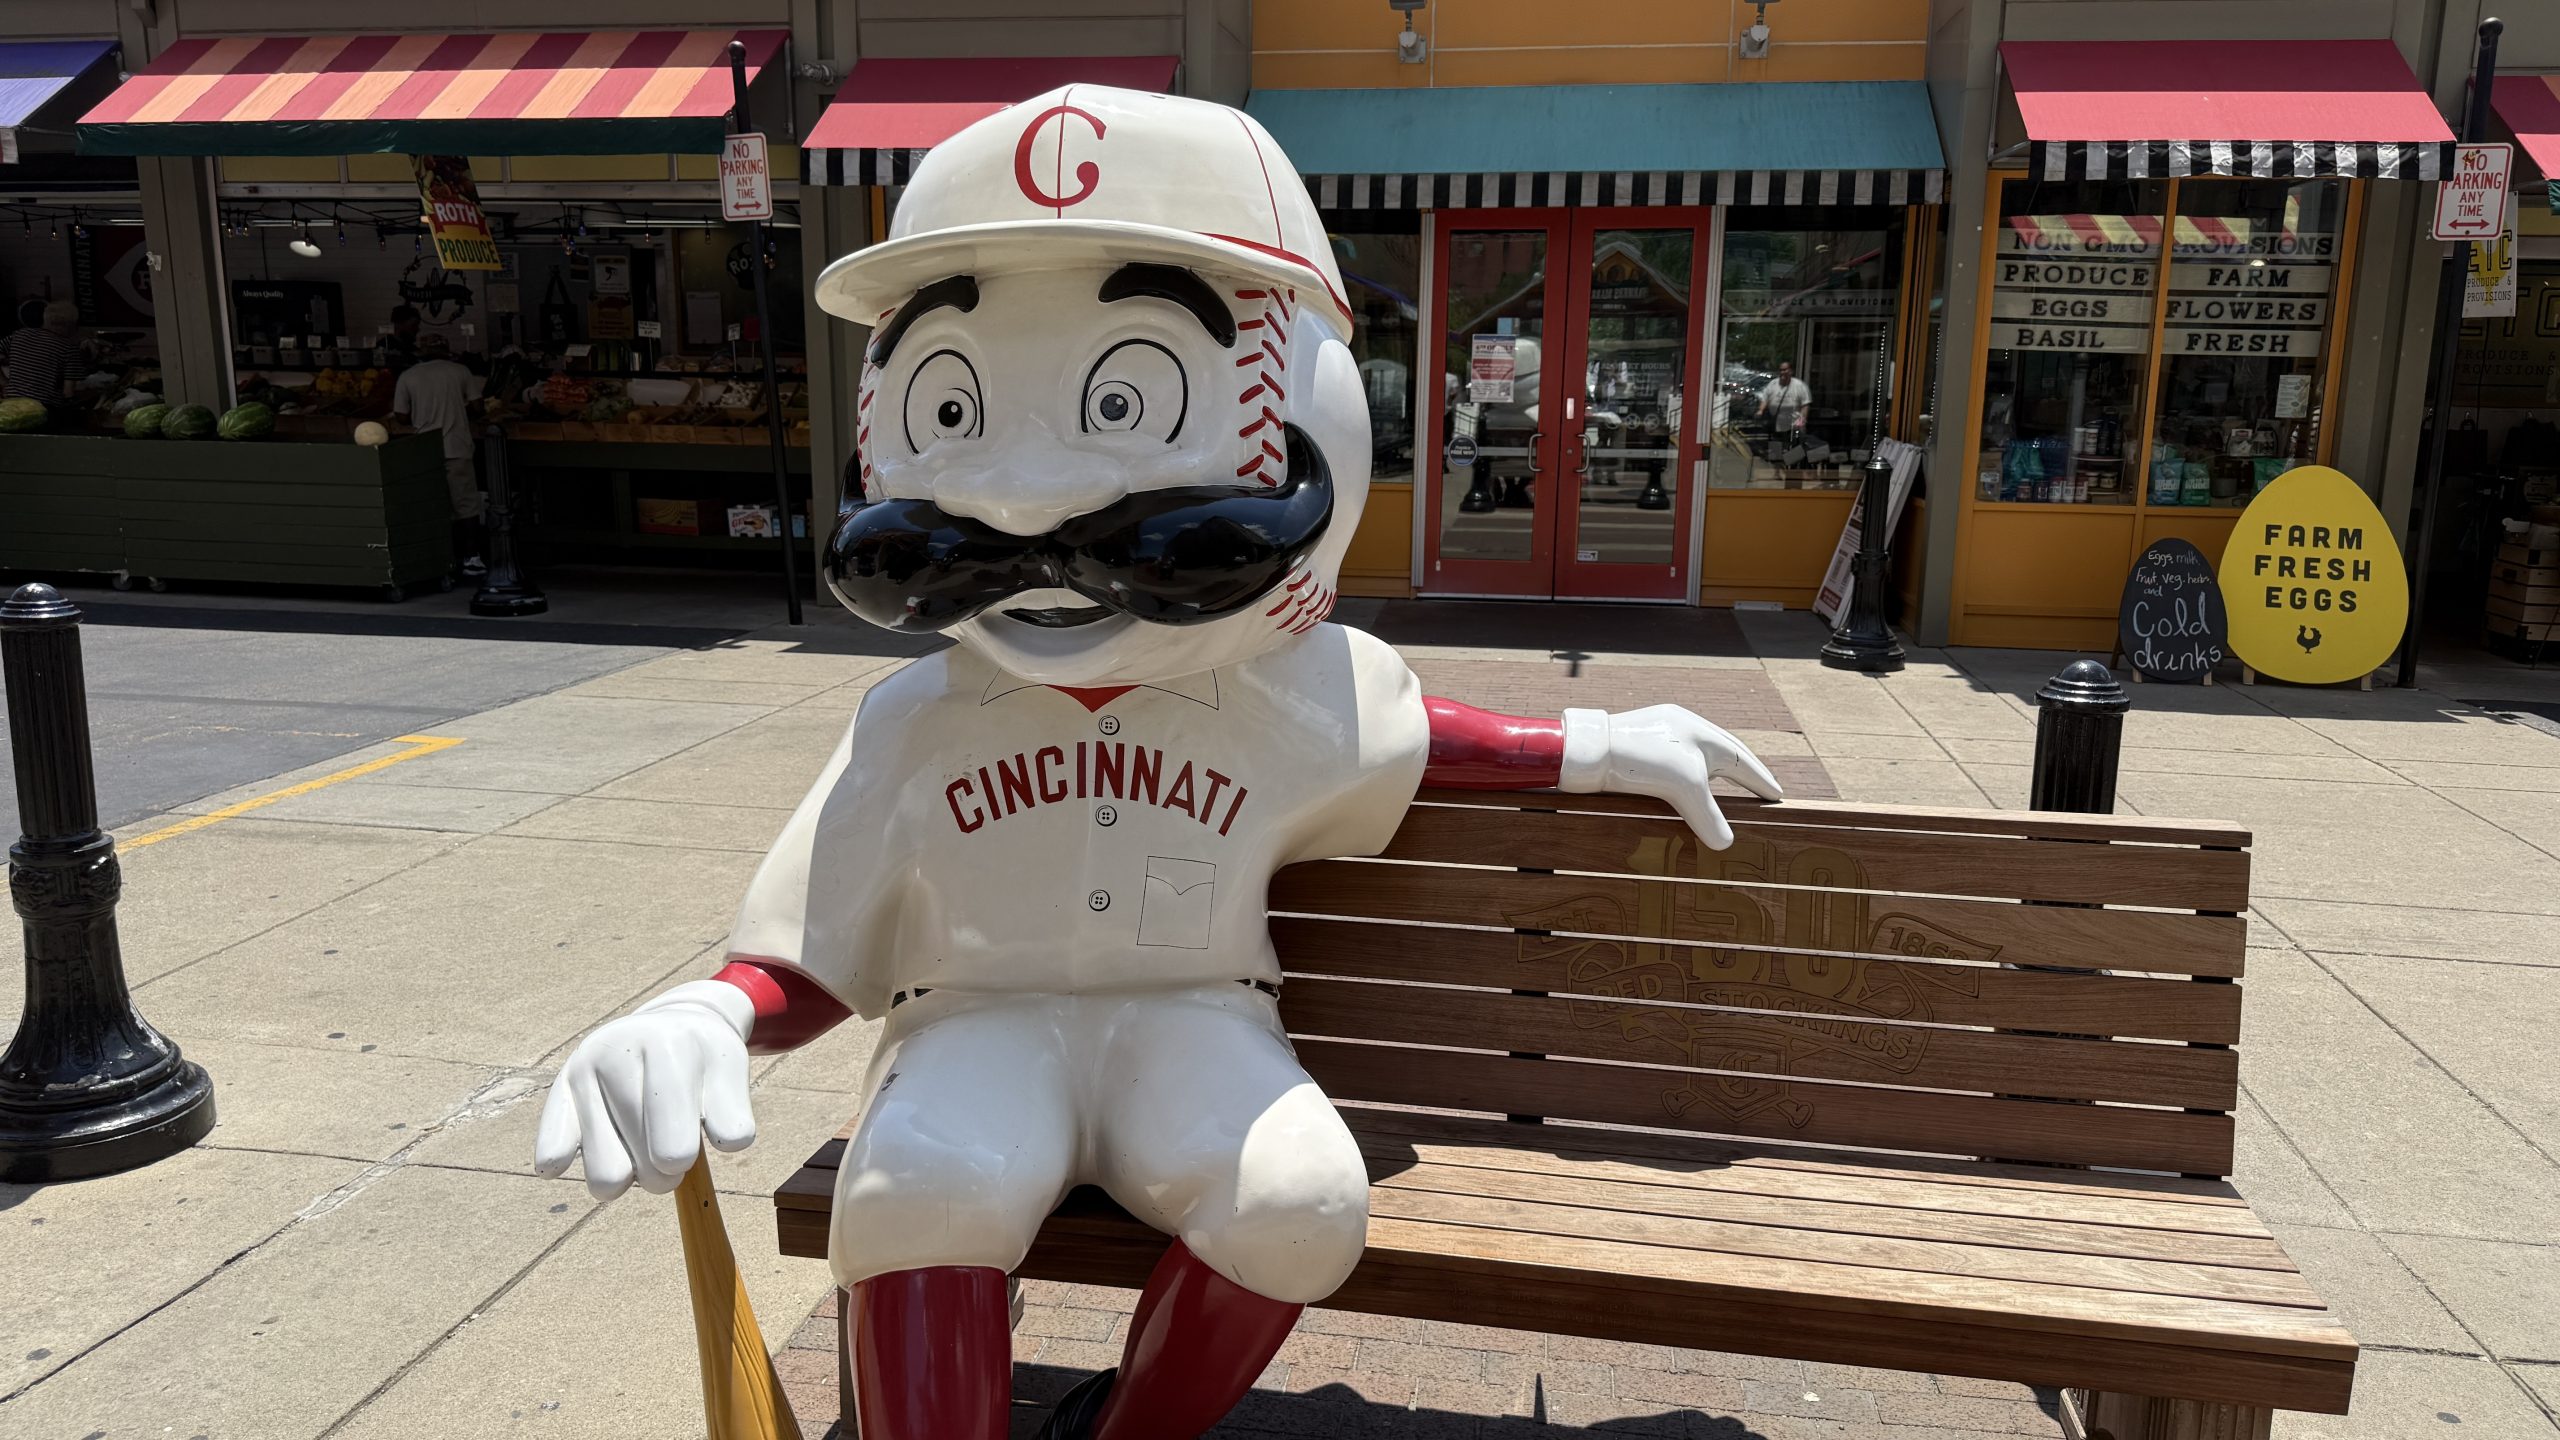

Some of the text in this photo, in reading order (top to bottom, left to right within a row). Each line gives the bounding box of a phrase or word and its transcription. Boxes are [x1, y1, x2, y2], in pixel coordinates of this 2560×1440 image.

[733, 143, 750, 159] NO
[1015, 105, 1107, 208] C
[723, 160, 764, 177] PARKING
[736, 176, 753, 188] ANY
[736, 187, 756, 200] TIME
[2459, 191, 2485, 204] ANY
[433, 202, 480, 226] ROTH
[2457, 204, 2484, 217] TIME
[438, 238, 499, 263] PRODUCE
[2014, 232, 2072, 251] NON
[2085, 235, 2149, 254] GMO
[2004, 264, 2149, 286] PRODUCE
[2208, 268, 2290, 288] FARM
[2466, 276, 2500, 288] PRODUCE
[2466, 290, 2512, 302] PROVISIONS
[2030, 299, 2109, 318] EGGS
[2165, 300, 2317, 321] FLOWERS
[2016, 328, 2105, 348] BASIL
[2185, 333, 2290, 352] FRESH
[2456, 364, 2555, 376] ROVISIONS
[2265, 524, 2363, 550] FARM
[2254, 555, 2371, 582] FRESH
[2143, 586, 2163, 596] and
[2265, 586, 2357, 612] EGGS
[2133, 591, 2210, 637] Cold
[2134, 637, 2221, 671] drinks
[946, 741, 1248, 836] CINCINNATI
[1624, 835, 1869, 1000] 150
[1592, 975, 1914, 1060] RED STOCKINGS
